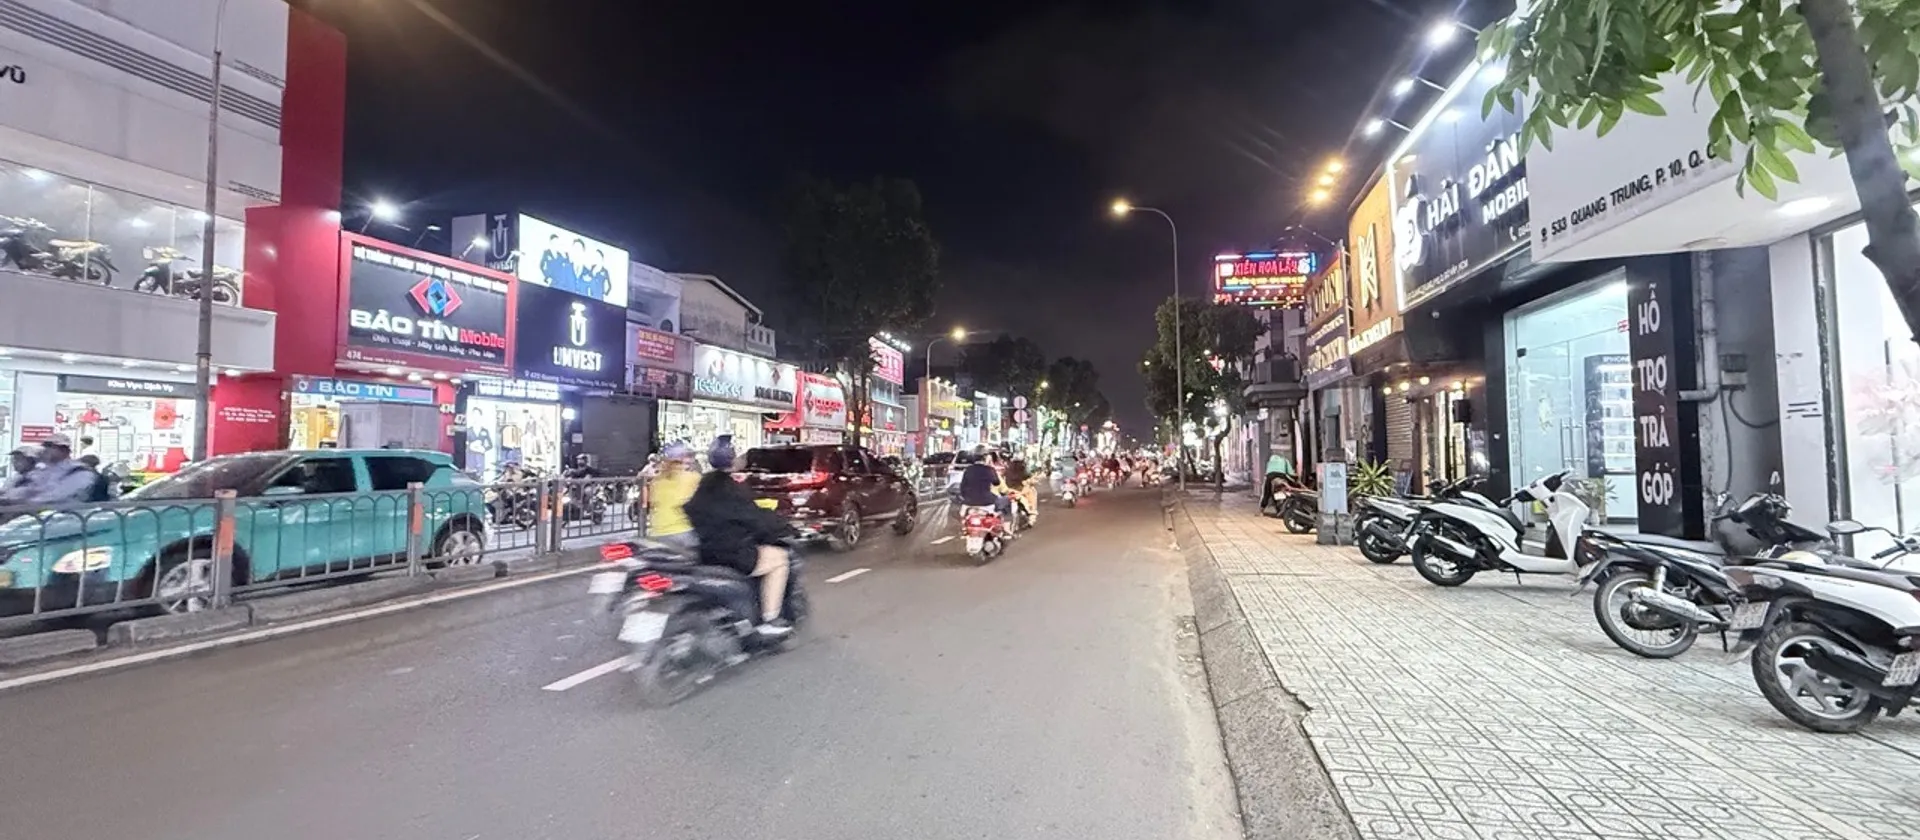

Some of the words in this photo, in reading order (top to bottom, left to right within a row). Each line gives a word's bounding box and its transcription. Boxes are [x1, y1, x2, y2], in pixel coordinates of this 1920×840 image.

[1426, 180, 1459, 232] HẢI
[1467, 132, 1521, 200] ĐĂN
[1551, 216, 1567, 236] 533
[1570, 197, 1607, 226] QUANG
[1610, 174, 1653, 207] TRUNG,
[1655, 167, 1667, 186] P.
[1668, 158, 1686, 179] 10,
[1688, 150, 1704, 169] Q.
[350, 308, 414, 335] BẢO
[417, 319, 459, 342] TÍN
[460, 328, 506, 349] Mobile
[1637, 282, 1660, 335] HỖ
[107, 379, 126, 388] Khu
[319, 380, 360, 395] BẢO
[364, 383, 393, 397] TÍN
[1637, 355, 1668, 396] TRỢ
[1640, 405, 1670, 447] TRẢ
[1641, 462, 1675, 506] GÓP
